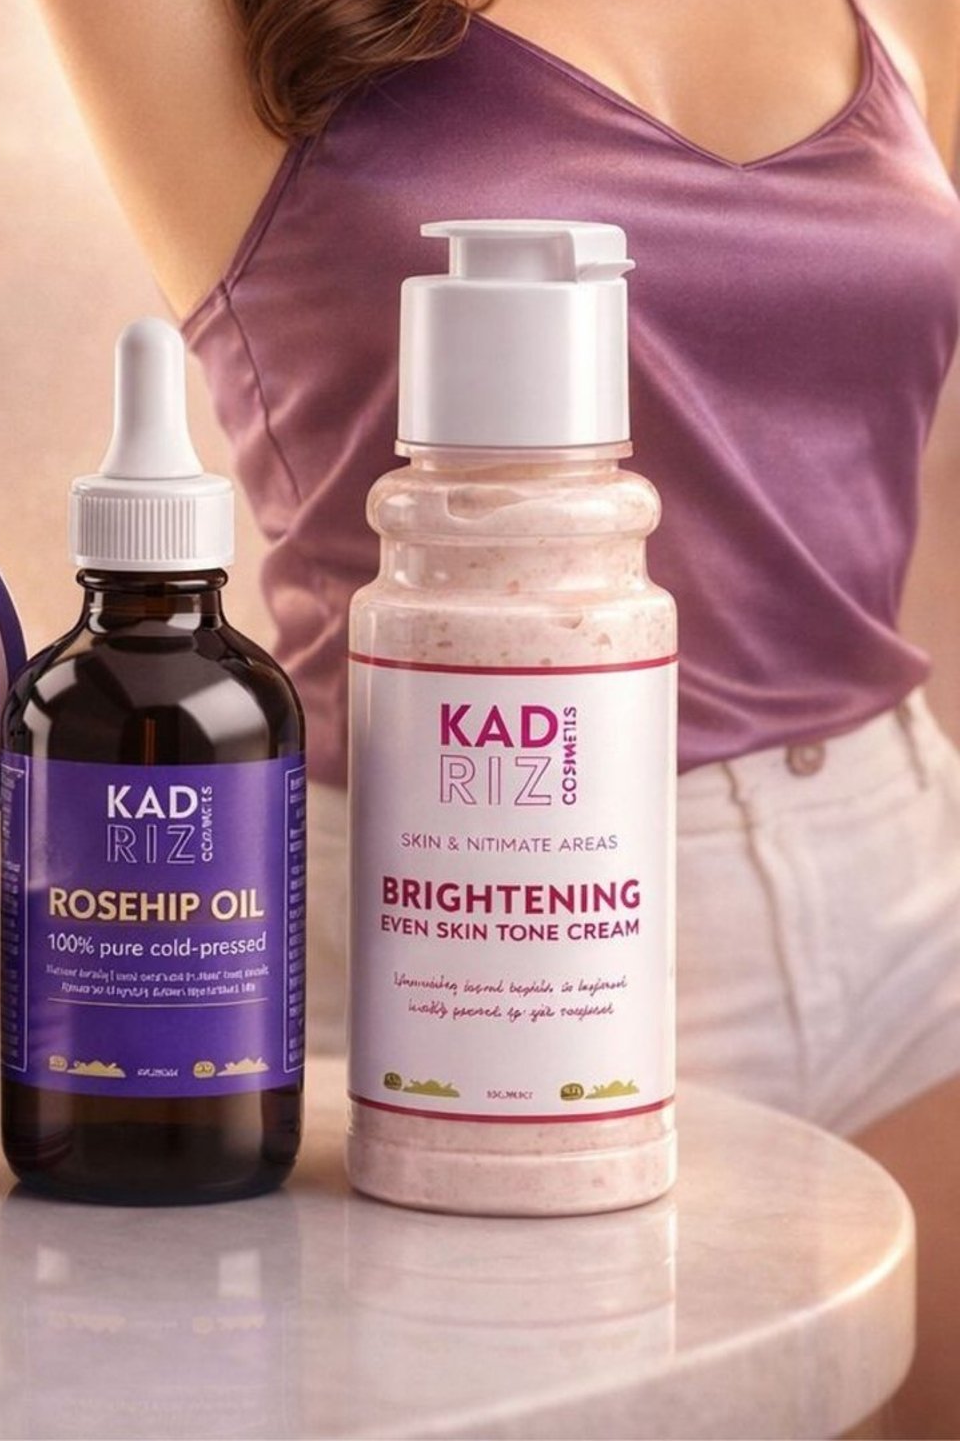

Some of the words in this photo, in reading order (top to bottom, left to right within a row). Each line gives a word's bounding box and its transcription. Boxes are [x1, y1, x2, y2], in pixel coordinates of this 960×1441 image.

[441, 704, 558, 748] KAD
[440, 755, 552, 806] RIZ
[107, 785, 198, 819] KAD
[107, 824, 196, 864] RIZ
[401, 833, 441, 851] SKIN
[447, 836, 459, 851] &
[559, 835, 618, 852] AREAS
[49, 887, 200, 921] ROSEHIP
[211, 888, 264, 920] OIL
[382, 876, 641, 915] BRIGHTENING
[47, 932, 95, 955] 100%
[100, 942, 144, 958] pure
[150, 931, 267, 958] cold-pressed
[381, 914, 429, 937] EVEN
[436, 922, 488, 940] SKIN
[496, 924, 559, 942] TONE
[567, 918, 640, 941] CREAM
